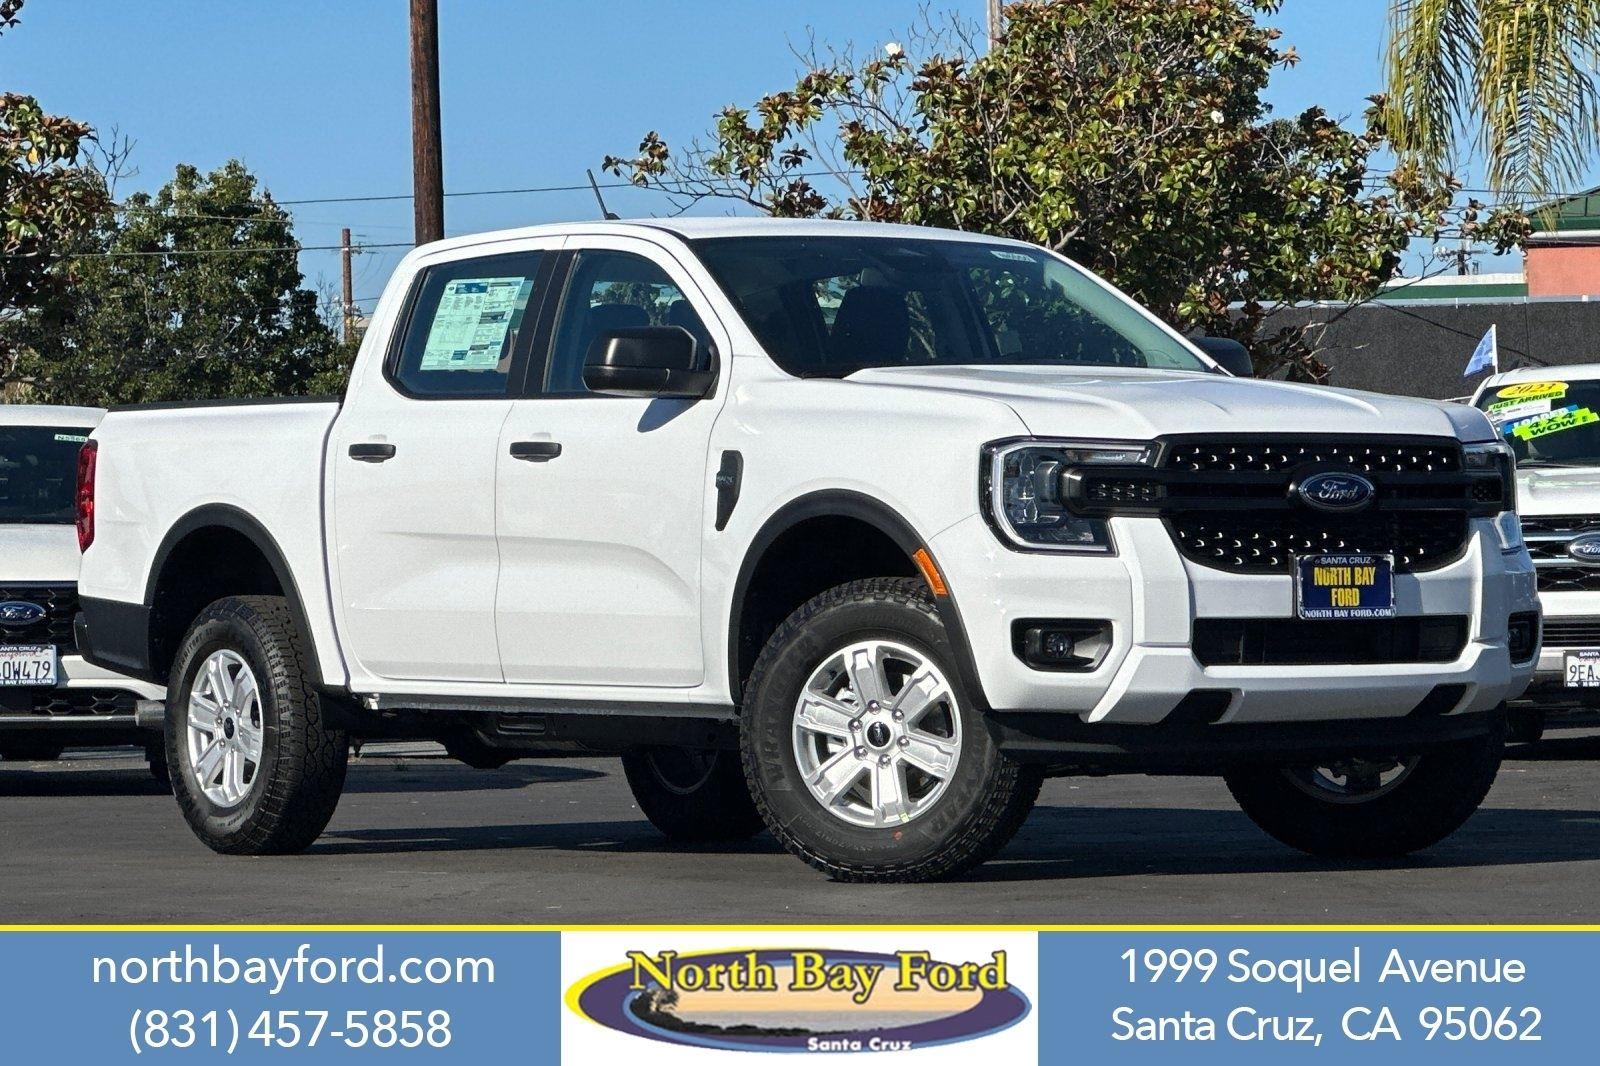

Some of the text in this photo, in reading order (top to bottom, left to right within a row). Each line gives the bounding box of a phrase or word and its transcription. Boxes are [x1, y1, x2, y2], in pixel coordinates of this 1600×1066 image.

[1492, 391, 1563, 410] JUST ARRIVED
[1318, 479, 1359, 501] Ford
[1320, 556, 1371, 565] SANTA CRUZ
[1314, 566, 1376, 586] NORTH BAY
[1331, 587, 1360, 607] FORD
[1304, 608, 1392, 618] NORTH BAY FORD.COM
[0, 660, 51, 680] OW479
